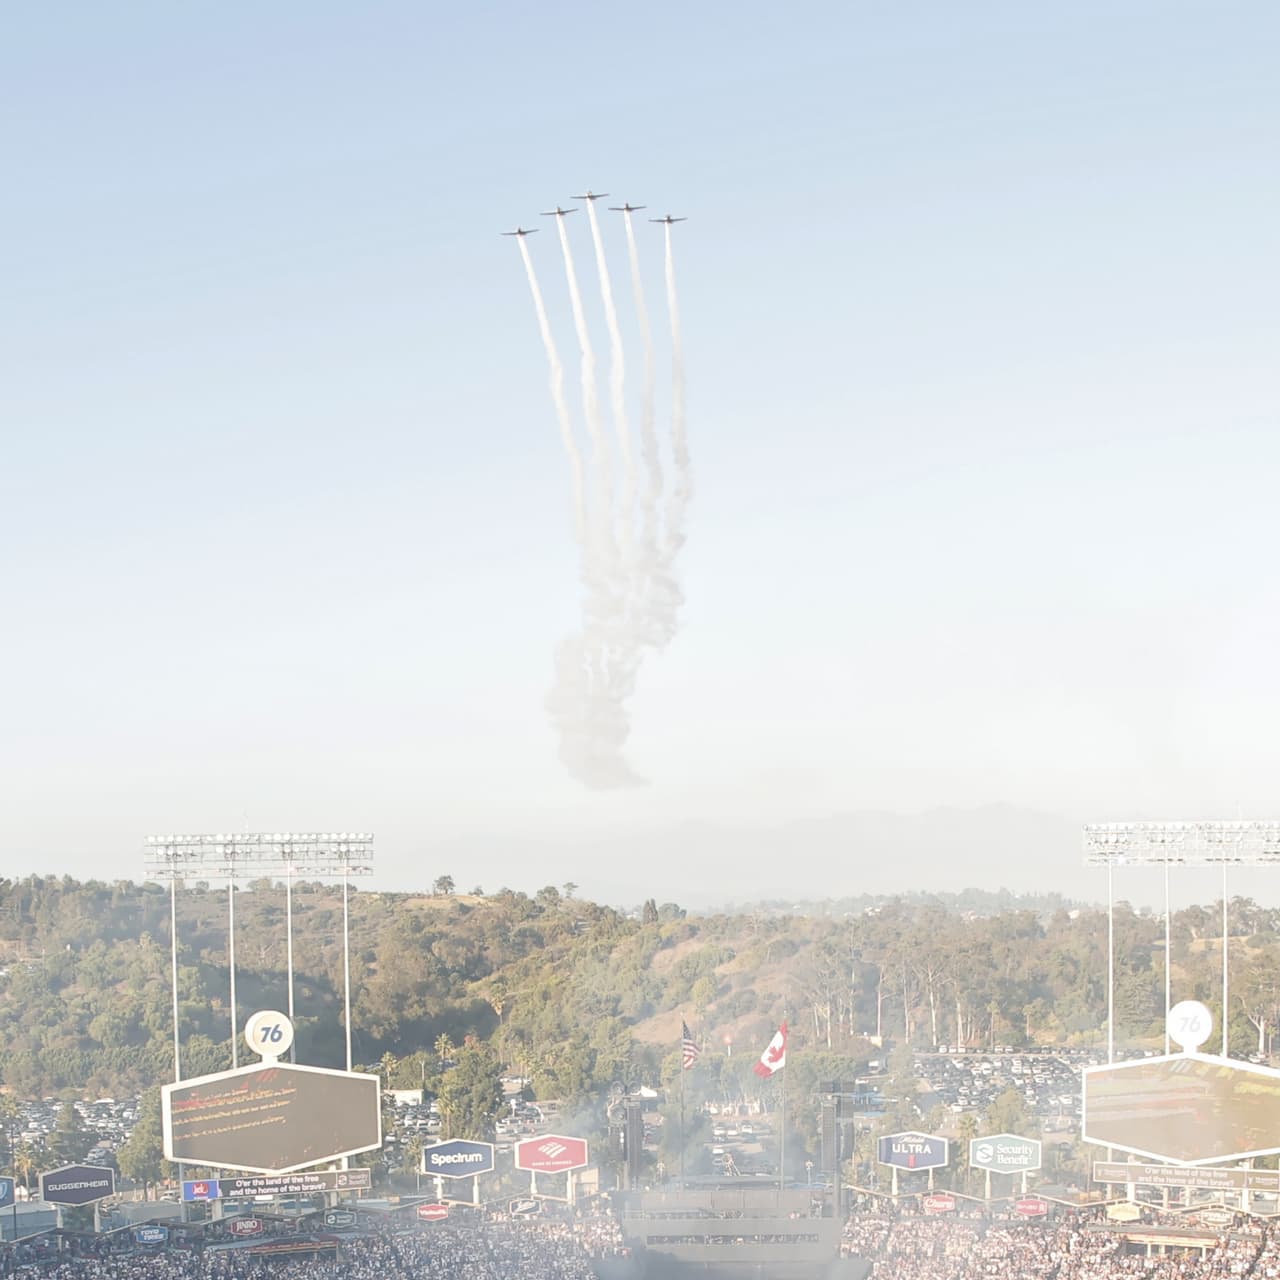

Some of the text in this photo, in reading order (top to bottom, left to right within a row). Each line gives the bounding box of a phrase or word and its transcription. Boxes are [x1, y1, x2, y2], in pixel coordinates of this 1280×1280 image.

[1179, 1015, 1201, 1033] 76
[260, 1023, 283, 1043] 76
[892, 1143, 932, 1154] ULTRA
[996, 1144, 1034, 1155] Security
[431, 1152, 483, 1166] Spectrum
[997, 1154, 1032, 1165] Benefit
[48, 1179, 109, 1192] GUGGENHEIM
[235, 1175, 320, 1187] O'er the land of the free
[229, 1182, 327, 1196] and the home of the brave?
